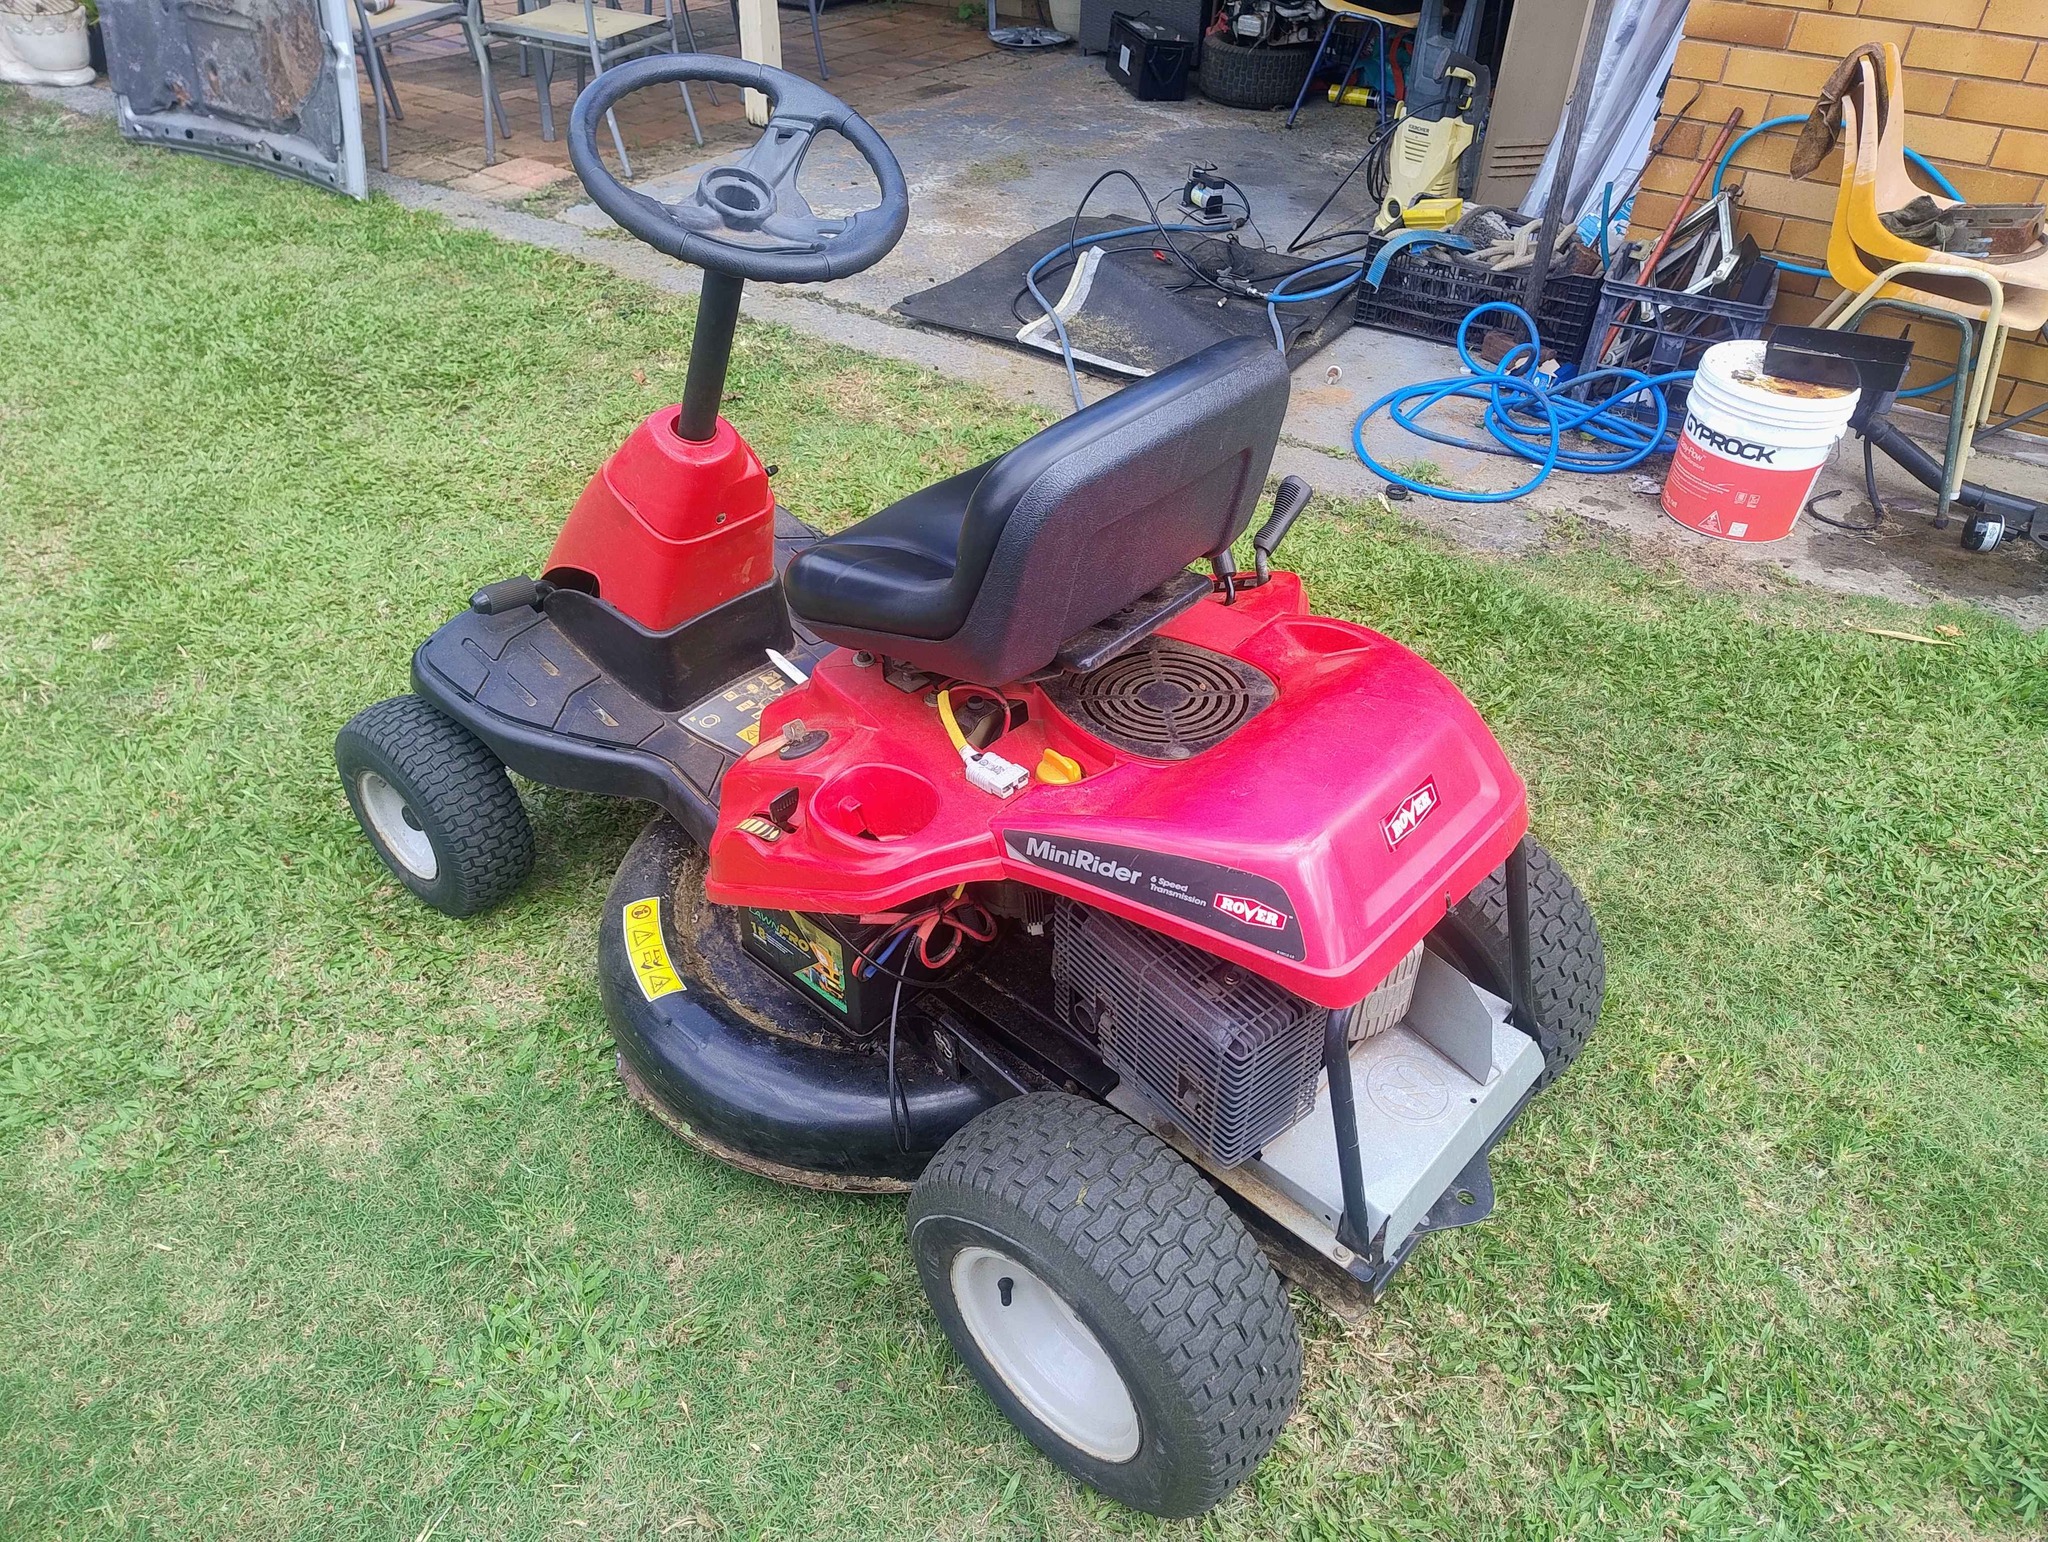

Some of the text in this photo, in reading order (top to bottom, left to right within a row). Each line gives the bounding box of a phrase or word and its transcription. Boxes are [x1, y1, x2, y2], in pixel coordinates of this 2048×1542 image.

[1687, 413, 1776, 464] GYPROCK
[1391, 791, 1432, 839] ROVER
[1026, 837, 1142, 885] MiniRider
[1150, 883, 1207, 907] Transmission
[1158, 877, 1188, 892] Speed
[1221, 897, 1278, 927] ROVER
